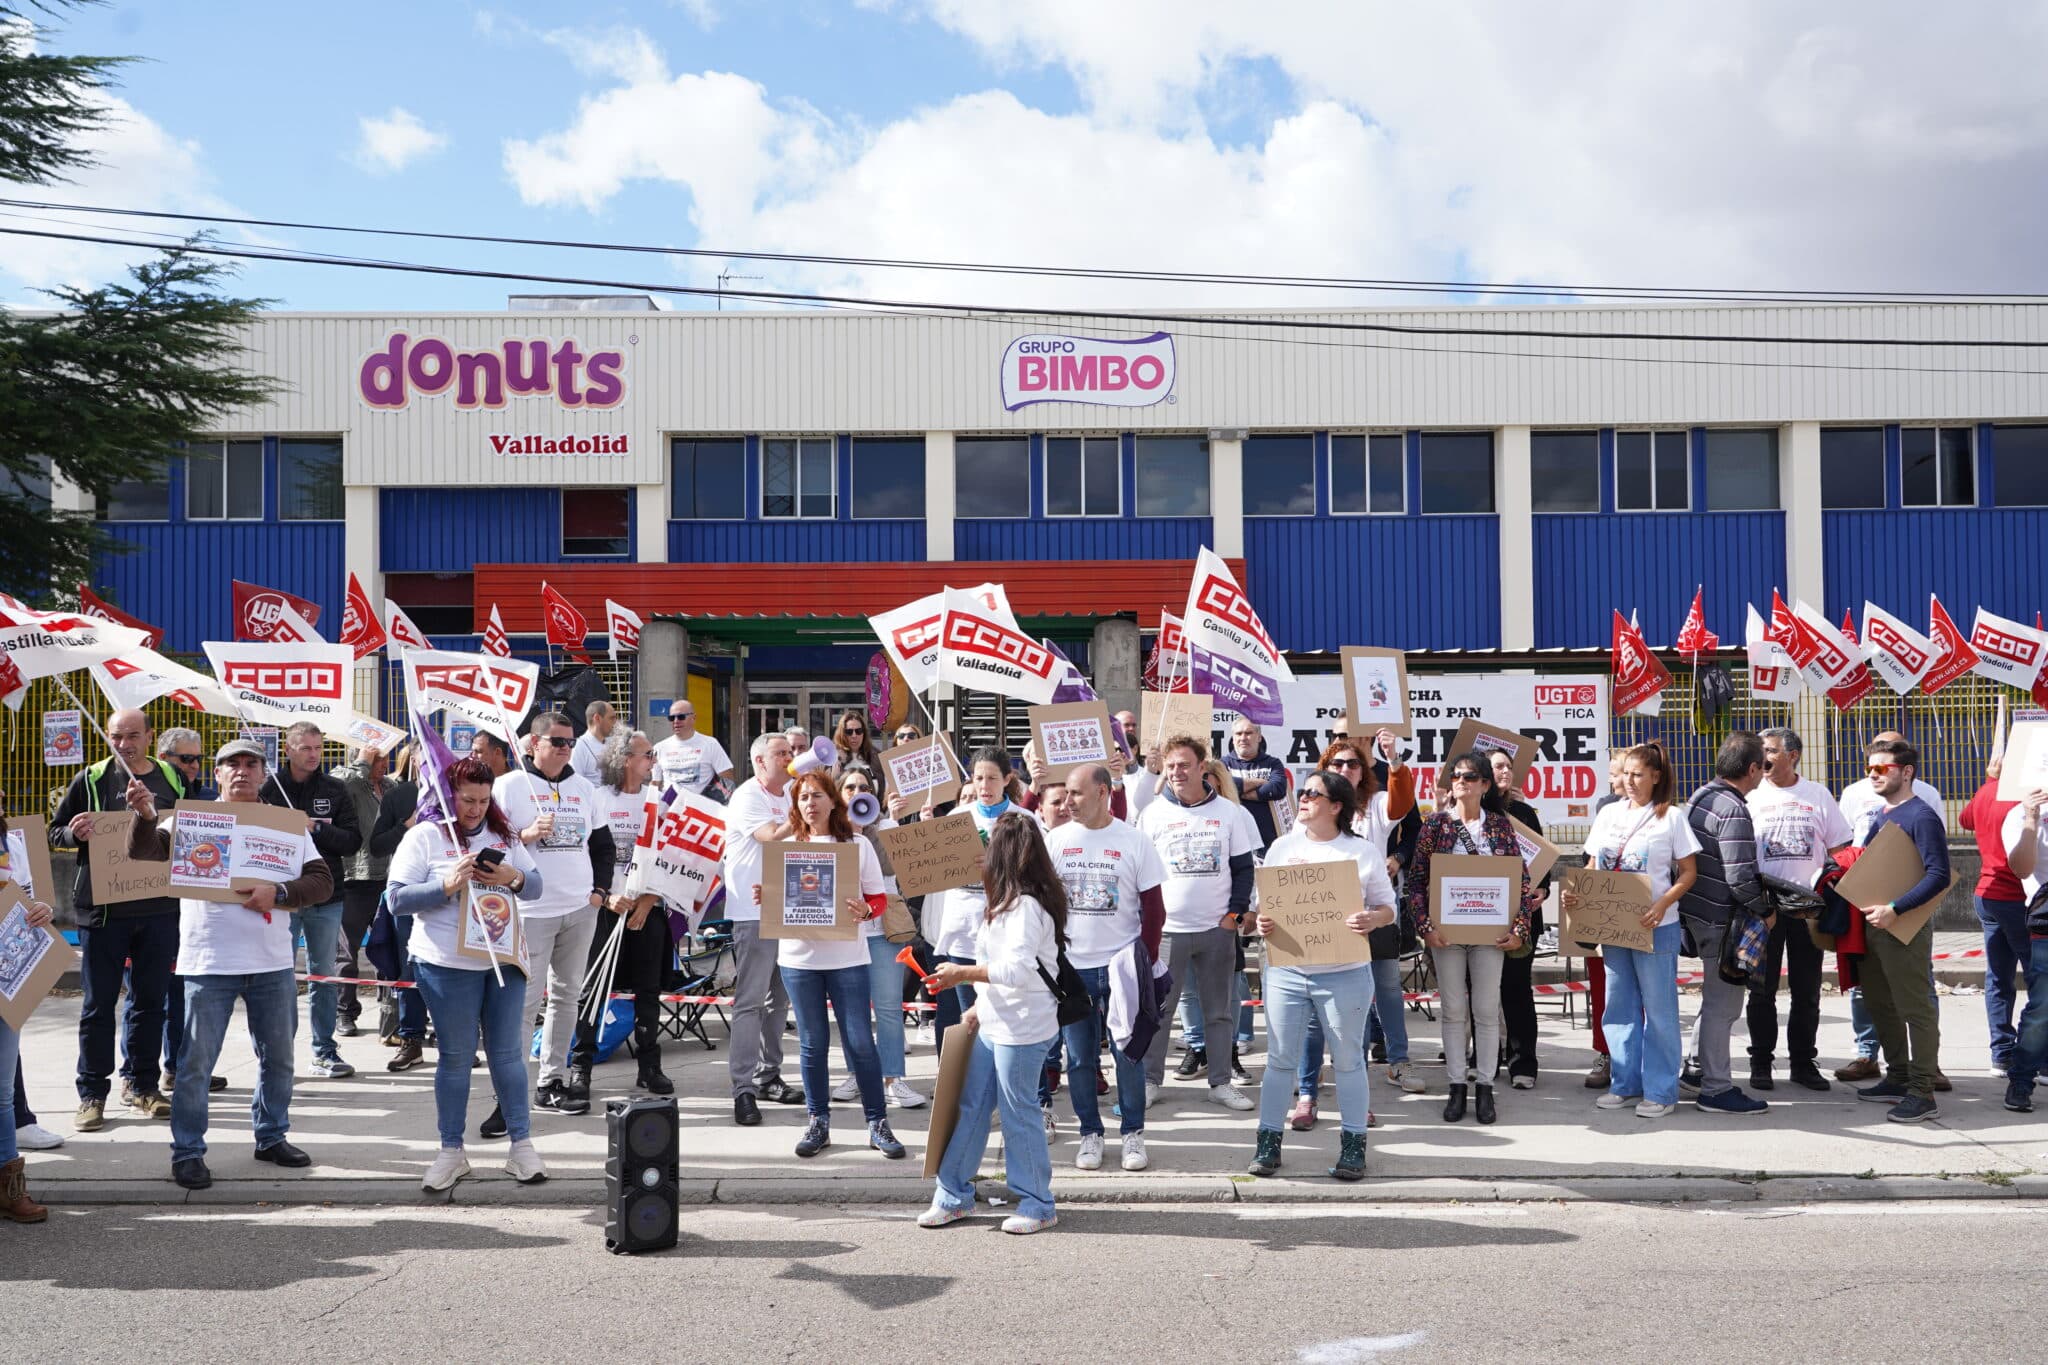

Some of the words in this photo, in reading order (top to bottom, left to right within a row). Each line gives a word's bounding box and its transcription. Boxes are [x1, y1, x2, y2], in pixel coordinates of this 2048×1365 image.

[1018, 341, 1075, 353] GRUPO
[360, 333, 625, 405] donuts
[1018, 355, 1165, 391] BIMBO
[489, 434, 629, 455] Valladolid
[249, 599, 282, 622] UG
[0, 632, 53, 651] astilla
[1203, 618, 1242, 645] Castilla
[949, 618, 1043, 672] CCOO
[1871, 622, 1923, 669] CCOO
[1976, 627, 2034, 657] CCOO
[955, 656, 1023, 679] Valladolid
[231, 668, 335, 691] CCOO
[1211, 682, 1247, 703] mujer
[1536, 687, 1576, 704] UGT
[300, 701, 331, 714] León
[1446, 707, 1482, 718] PAN
[1565, 708, 1596, 719] FICA
[945, 833, 972, 846] 200
[680, 863, 705, 882] León
[1065, 861, 1077, 869] NO
[1088, 861, 1116, 871] CIERRE
[908, 874, 933, 889] SIN
[943, 864, 973, 880] PAN
[1277, 867, 1327, 887] BIMBO
[1600, 877, 1625, 895] AL
[1266, 895, 1284, 910] SE
[1295, 890, 1337, 905] LLEVA
[1286, 911, 1343, 926] NUESTRO
[1304, 933, 1332, 948] PAN
